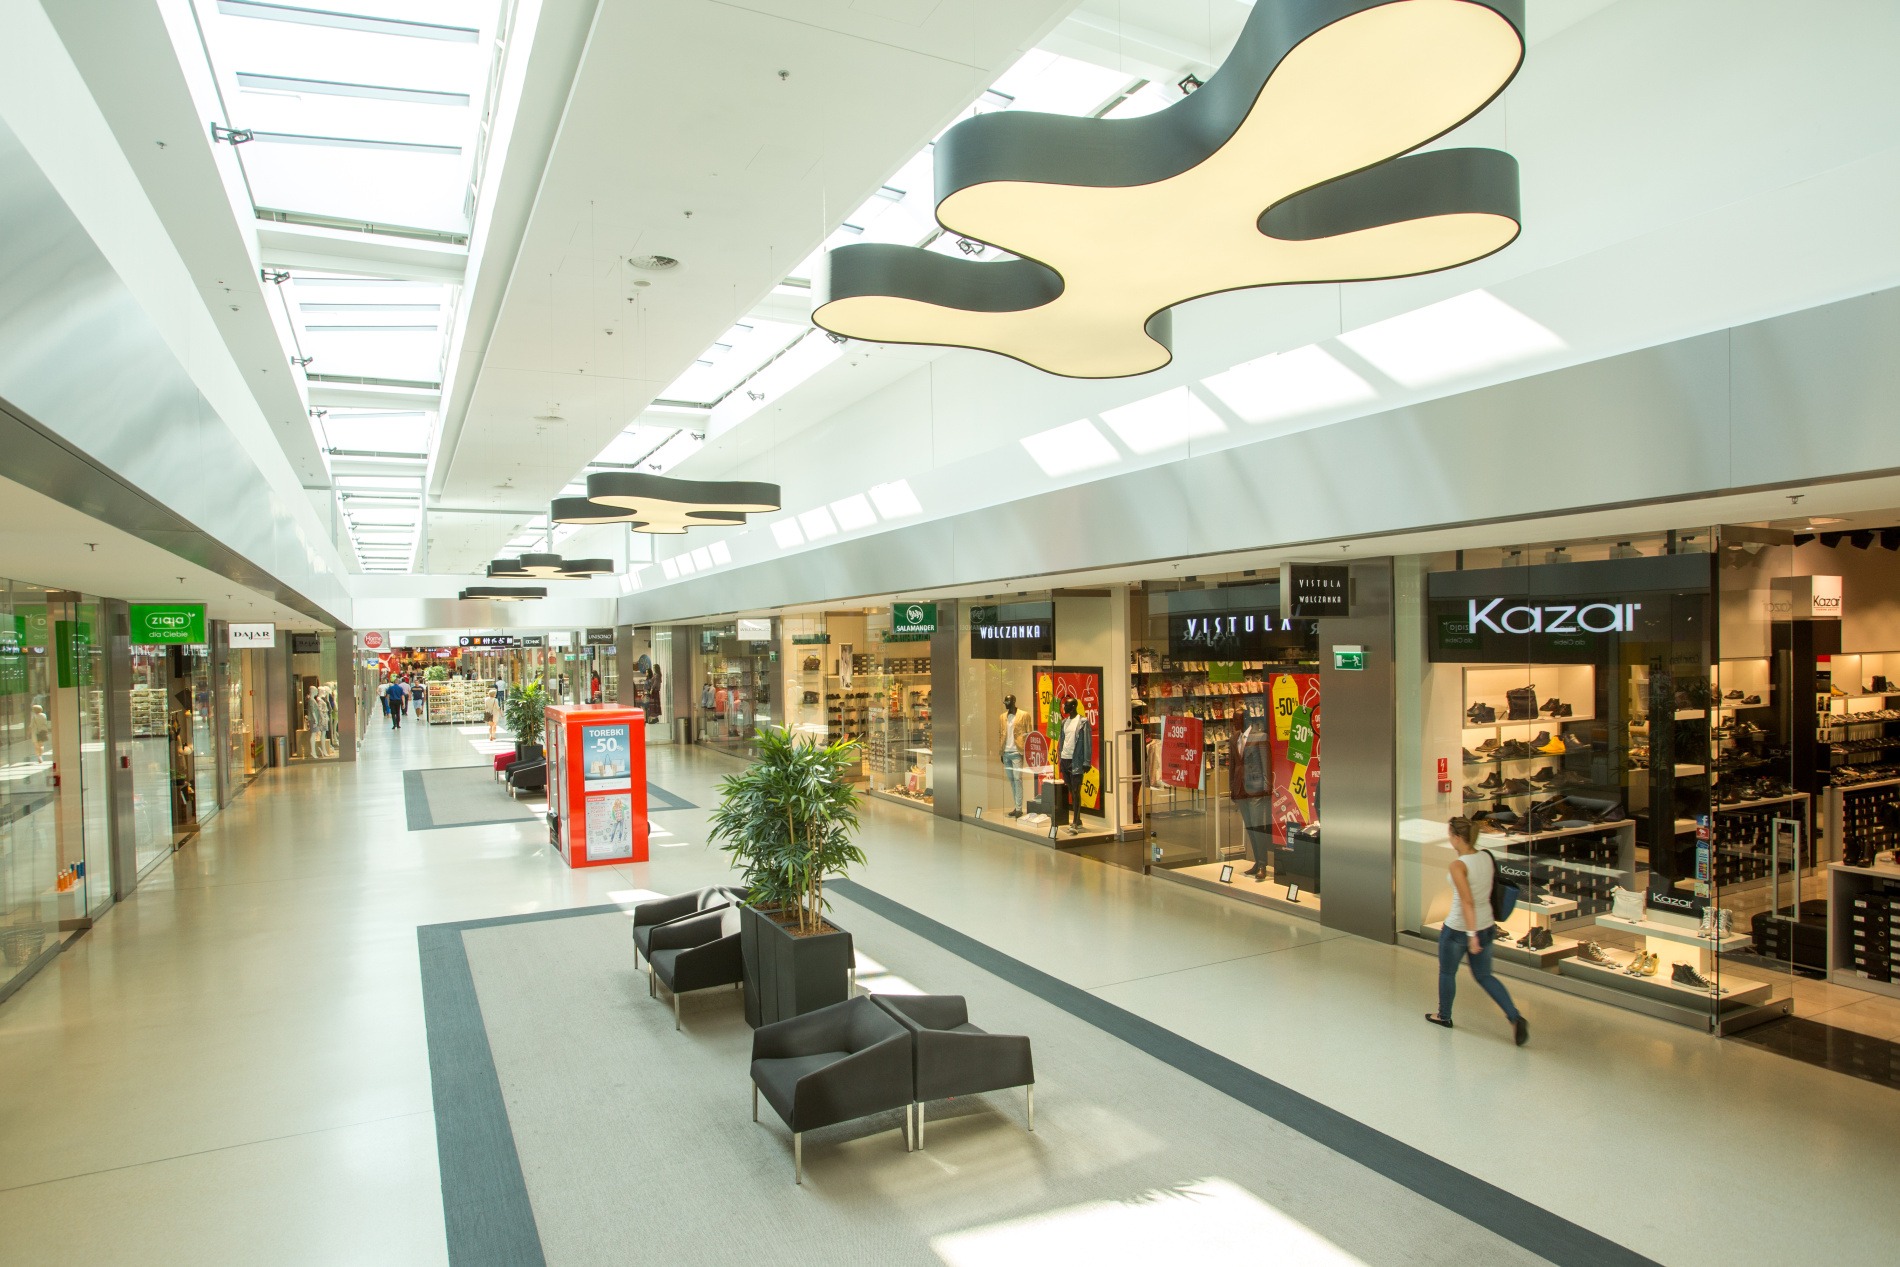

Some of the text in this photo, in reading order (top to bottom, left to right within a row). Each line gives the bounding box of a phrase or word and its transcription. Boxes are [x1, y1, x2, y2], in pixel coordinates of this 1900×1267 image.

[1299, 579, 1341, 588] VISTULA
[1813, 594, 1841, 607] Kazar
[151, 616, 184, 627] ziaja
[1468, 598, 1642, 634] Kazar
[896, 624, 935, 632] SALAMANDER
[1187, 614, 1292, 637] VISTULA
[234, 631, 270, 640] DAJAR
[1275, 697, 1298, 717] -50%
[589, 728, 624, 737] TOREBKI
[1292, 724, 1313, 743] -30%
[590, 737, 624, 753] -50%
[1652, 892, 1694, 909] Kazar
